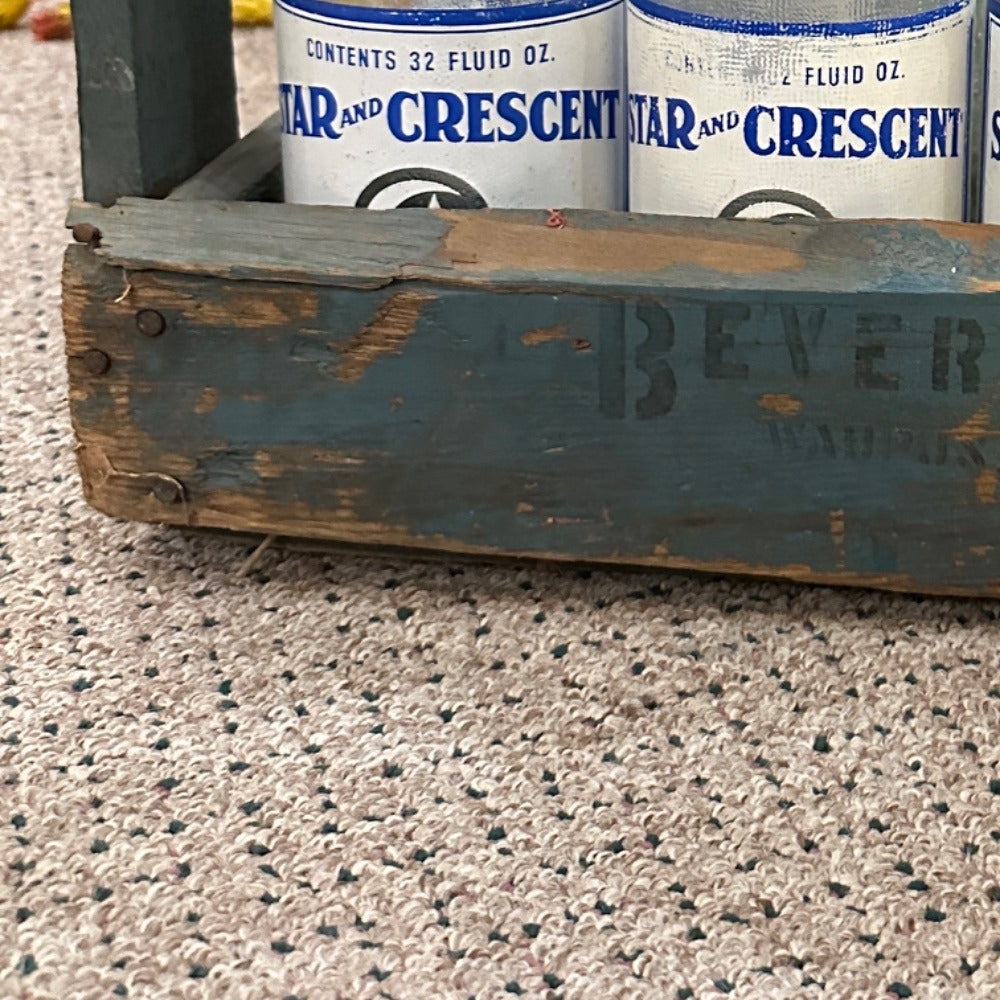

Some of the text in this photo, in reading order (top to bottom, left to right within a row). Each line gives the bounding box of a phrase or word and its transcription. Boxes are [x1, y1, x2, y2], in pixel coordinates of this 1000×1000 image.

[306, 37, 556, 71] CONTENTS 32 FLUID OZ.
[805, 65, 864, 86] FLUID
[876, 60, 905, 82] OZ.
[280, 83, 620, 142] TAR AND CRESCENT
[698, 110, 740, 139] AND
[743, 104, 961, 159] CRESCENT
